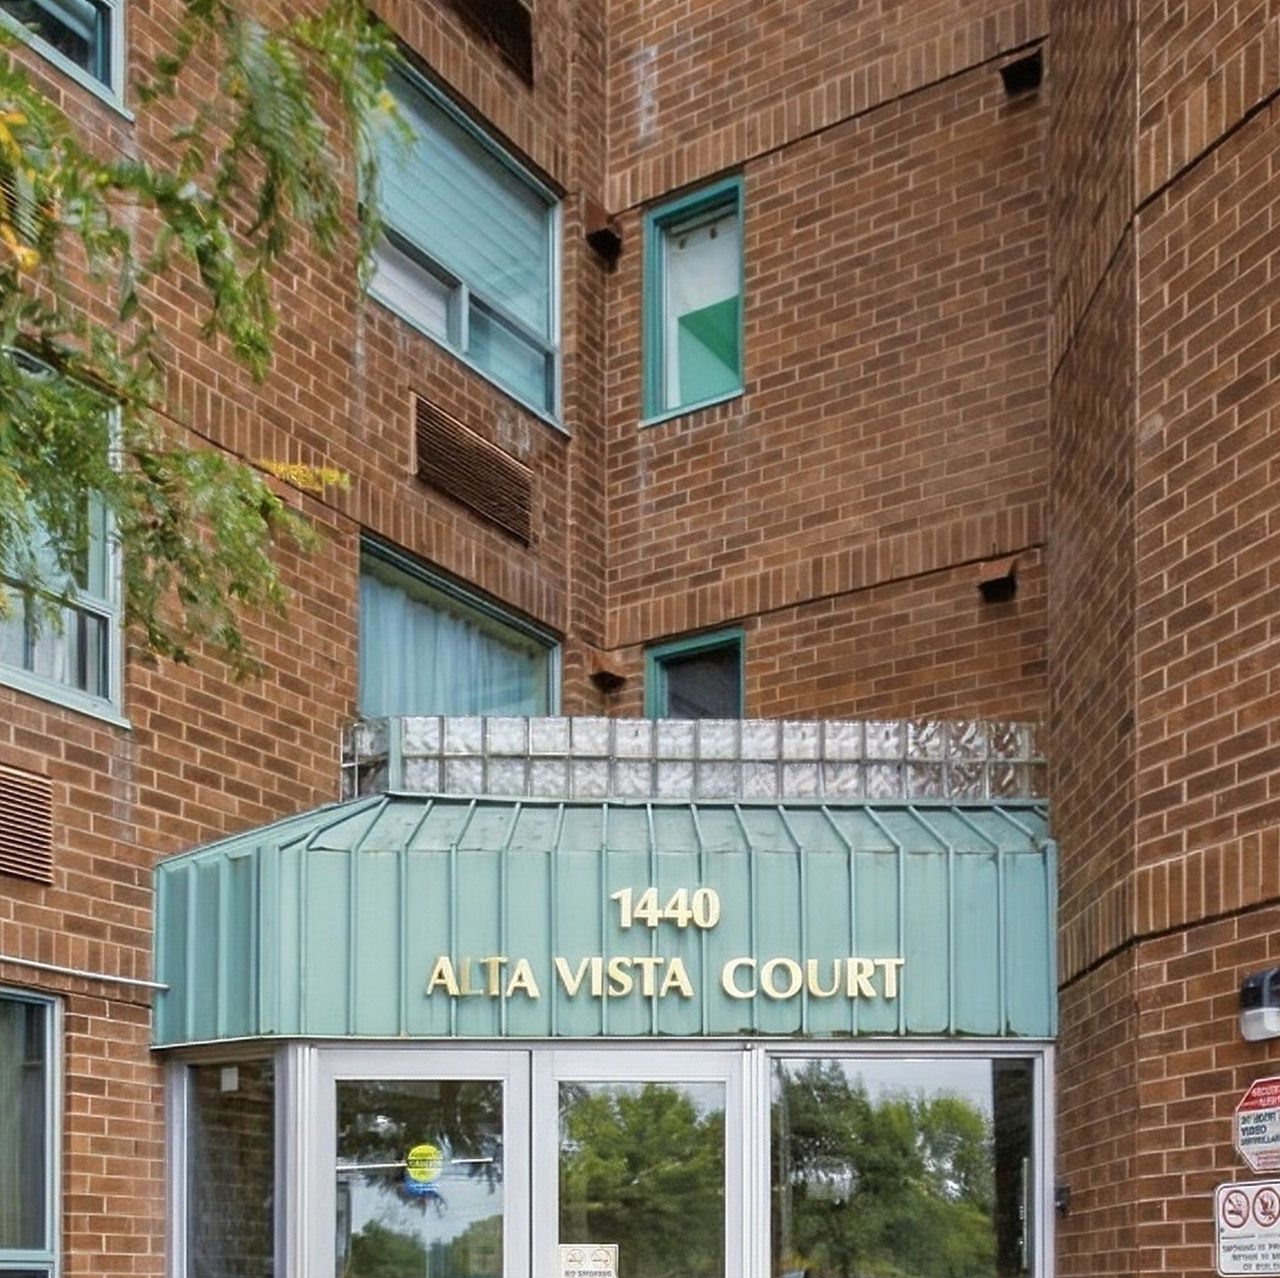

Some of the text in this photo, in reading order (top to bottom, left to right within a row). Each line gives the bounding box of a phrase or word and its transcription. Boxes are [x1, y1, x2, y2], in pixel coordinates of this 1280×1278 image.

[611, 887, 721, 929] 1440
[426, 955, 906, 1000] ALTA VISTA COURT
[1241, 1125, 1267, 1136] VIDEO
